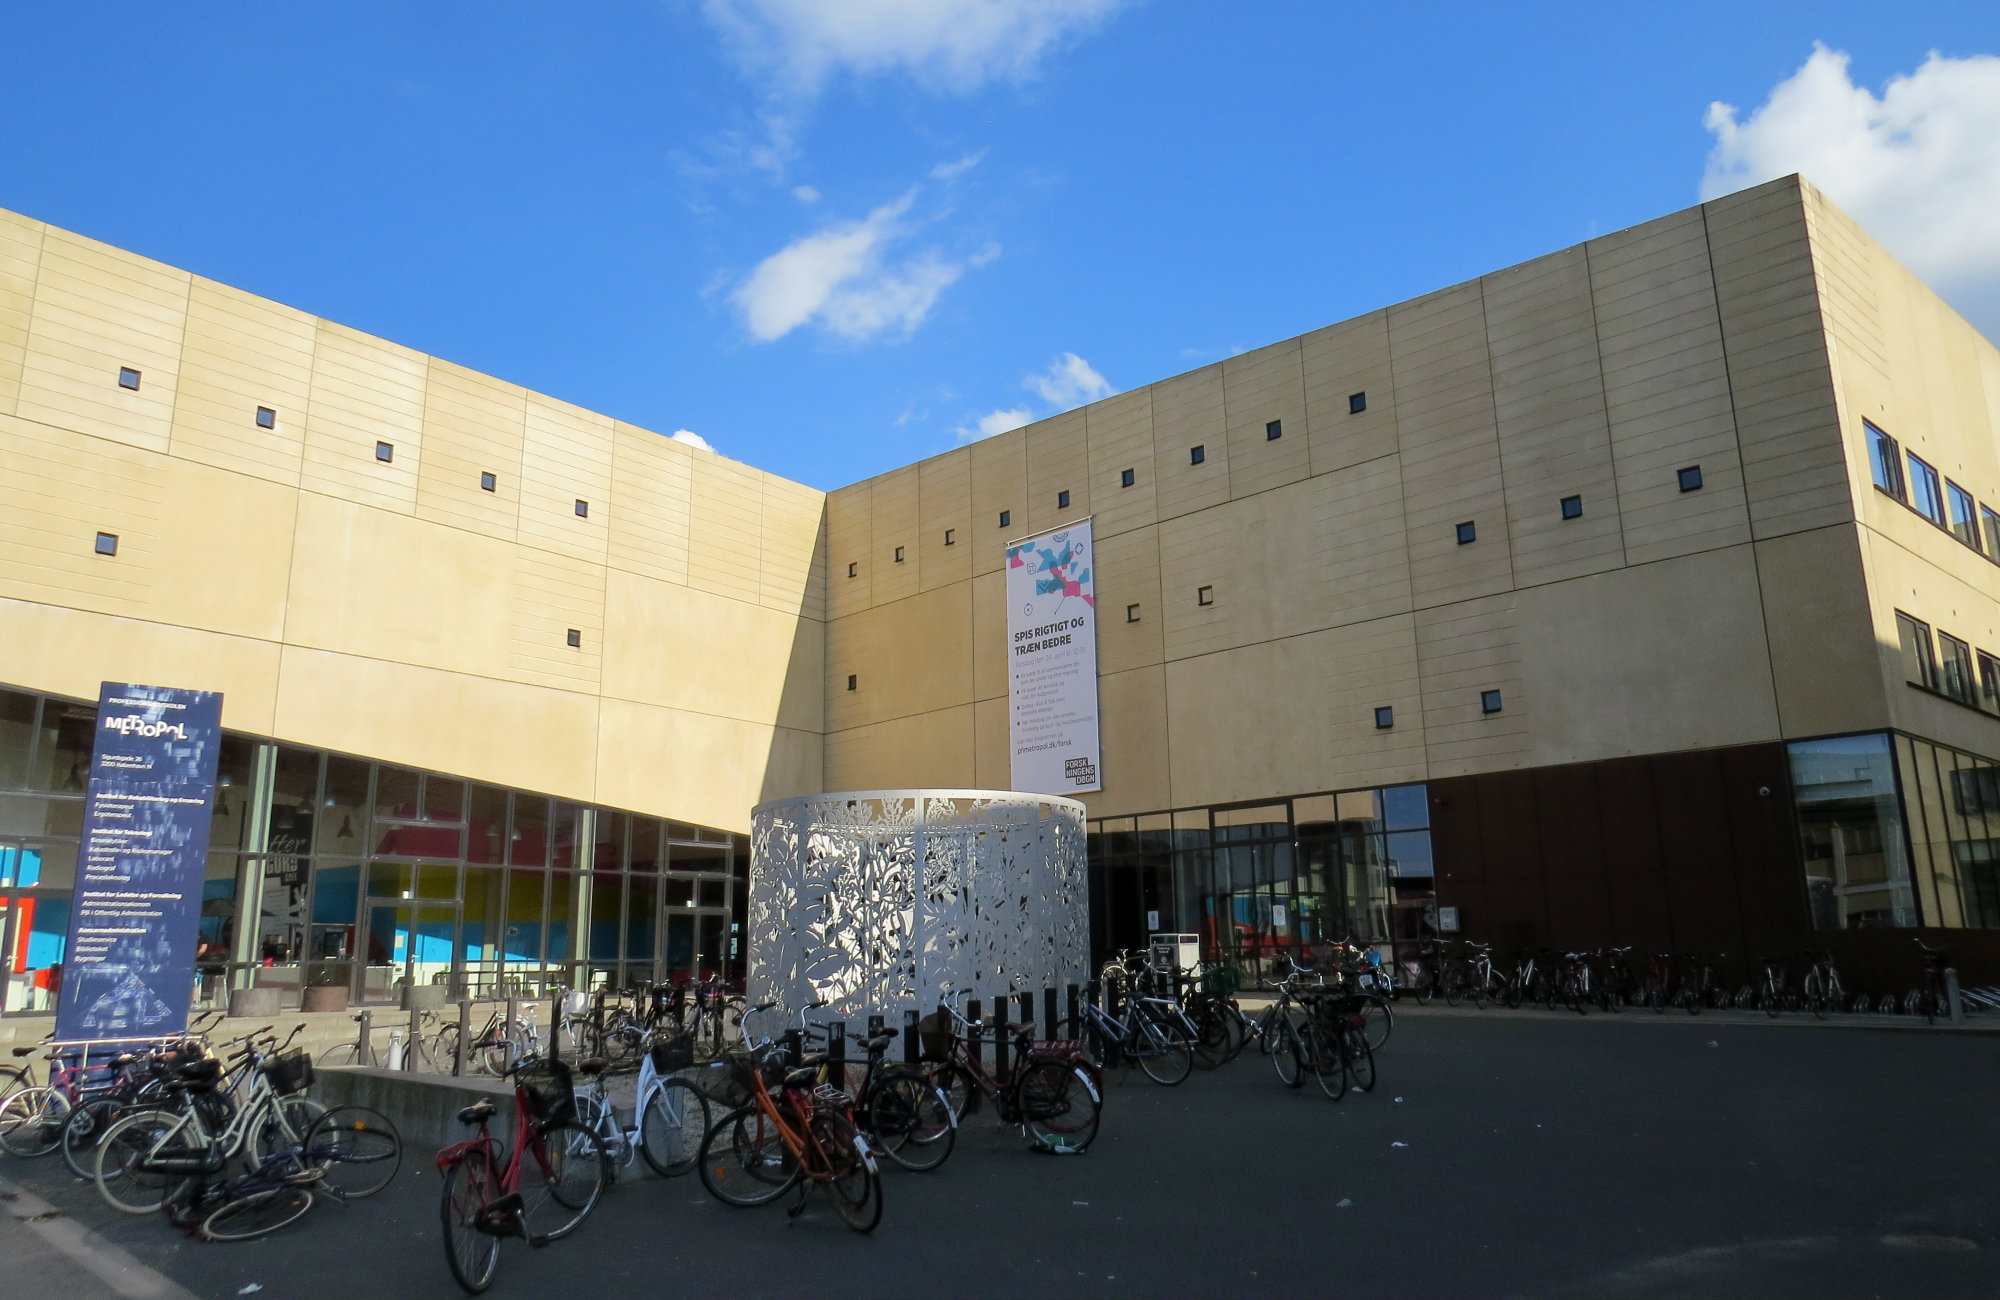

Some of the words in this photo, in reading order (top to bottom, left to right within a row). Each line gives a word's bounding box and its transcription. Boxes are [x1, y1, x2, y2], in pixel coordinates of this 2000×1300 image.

[1015, 629, 1033, 642] SPIS
[1035, 620, 1069, 638] RIGTIGT
[1071, 617, 1084, 628] OG
[1015, 641, 1040, 656] TRÆN
[1042, 634, 1071, 650] BEDRE
[105, 714, 187, 739] METROPOL
[1065, 758, 1087, 769] FORSK
[1066, 766, 1094, 777] NINGENS
